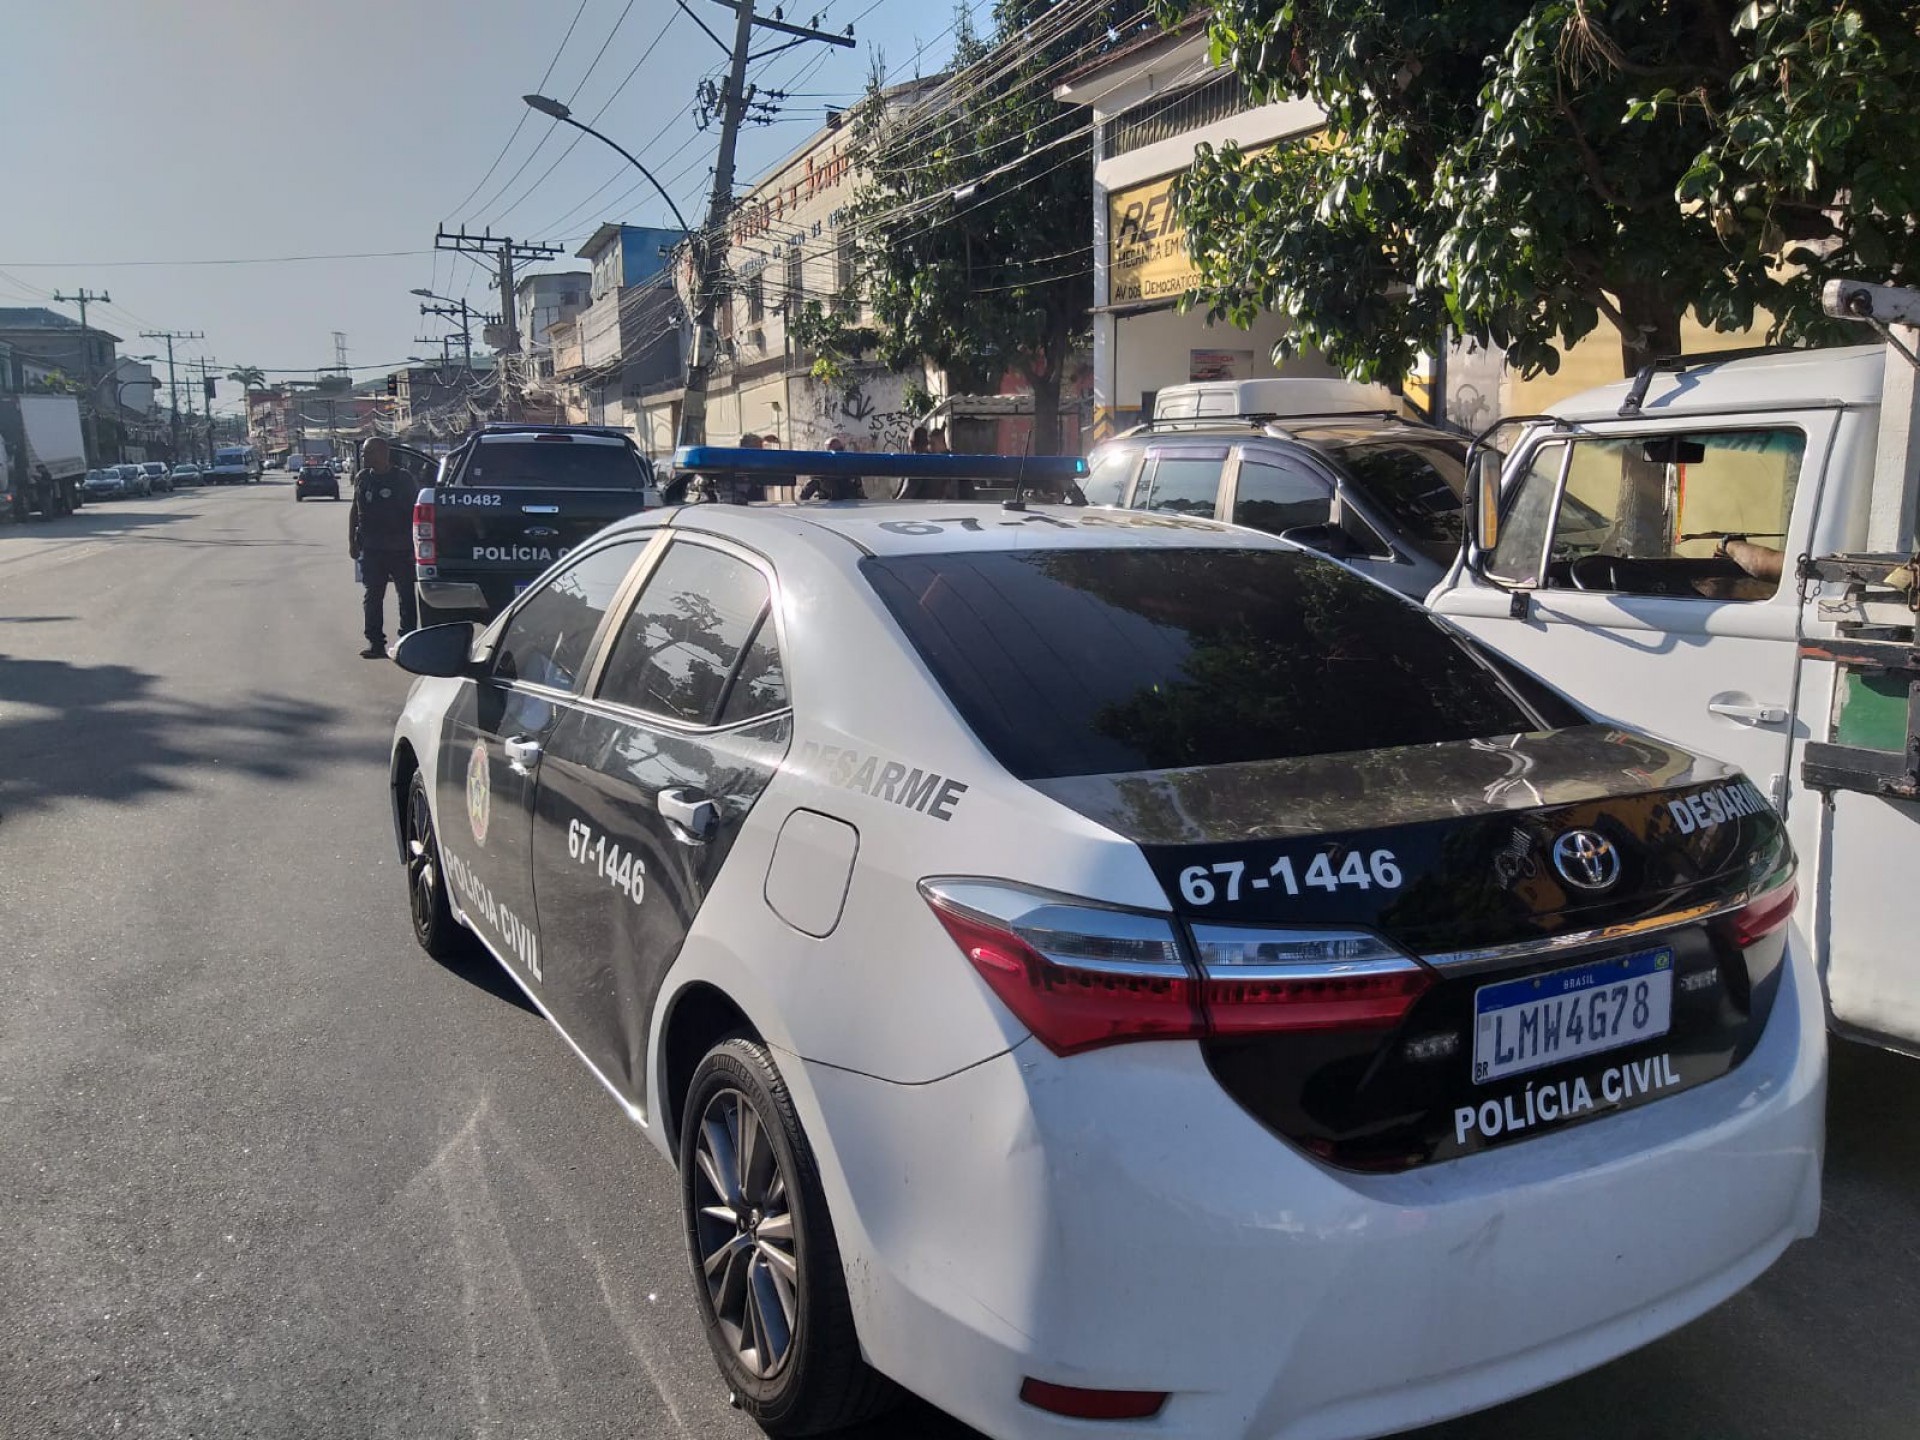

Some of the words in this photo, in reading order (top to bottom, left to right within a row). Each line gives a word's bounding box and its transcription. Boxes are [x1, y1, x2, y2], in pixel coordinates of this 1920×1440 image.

[439, 493, 502, 506] 11-0482
[472, 544, 552, 560] POLÍCIA
[801, 740, 969, 822] DESARME
[569, 818, 646, 905] 67-1446
[1179, 849, 1402, 906] 67-1446
[444, 846, 499, 932] POLÍCIA
[500, 903, 543, 985] CIVIL
[1563, 974, 1595, 990] BRASIL
[1494, 981, 1650, 1065] LMW4G78
[1454, 1077, 1594, 1145] POLÍCIA
[1602, 1053, 1681, 1103] CIVIL
[1476, 1061, 1489, 1078] BR
